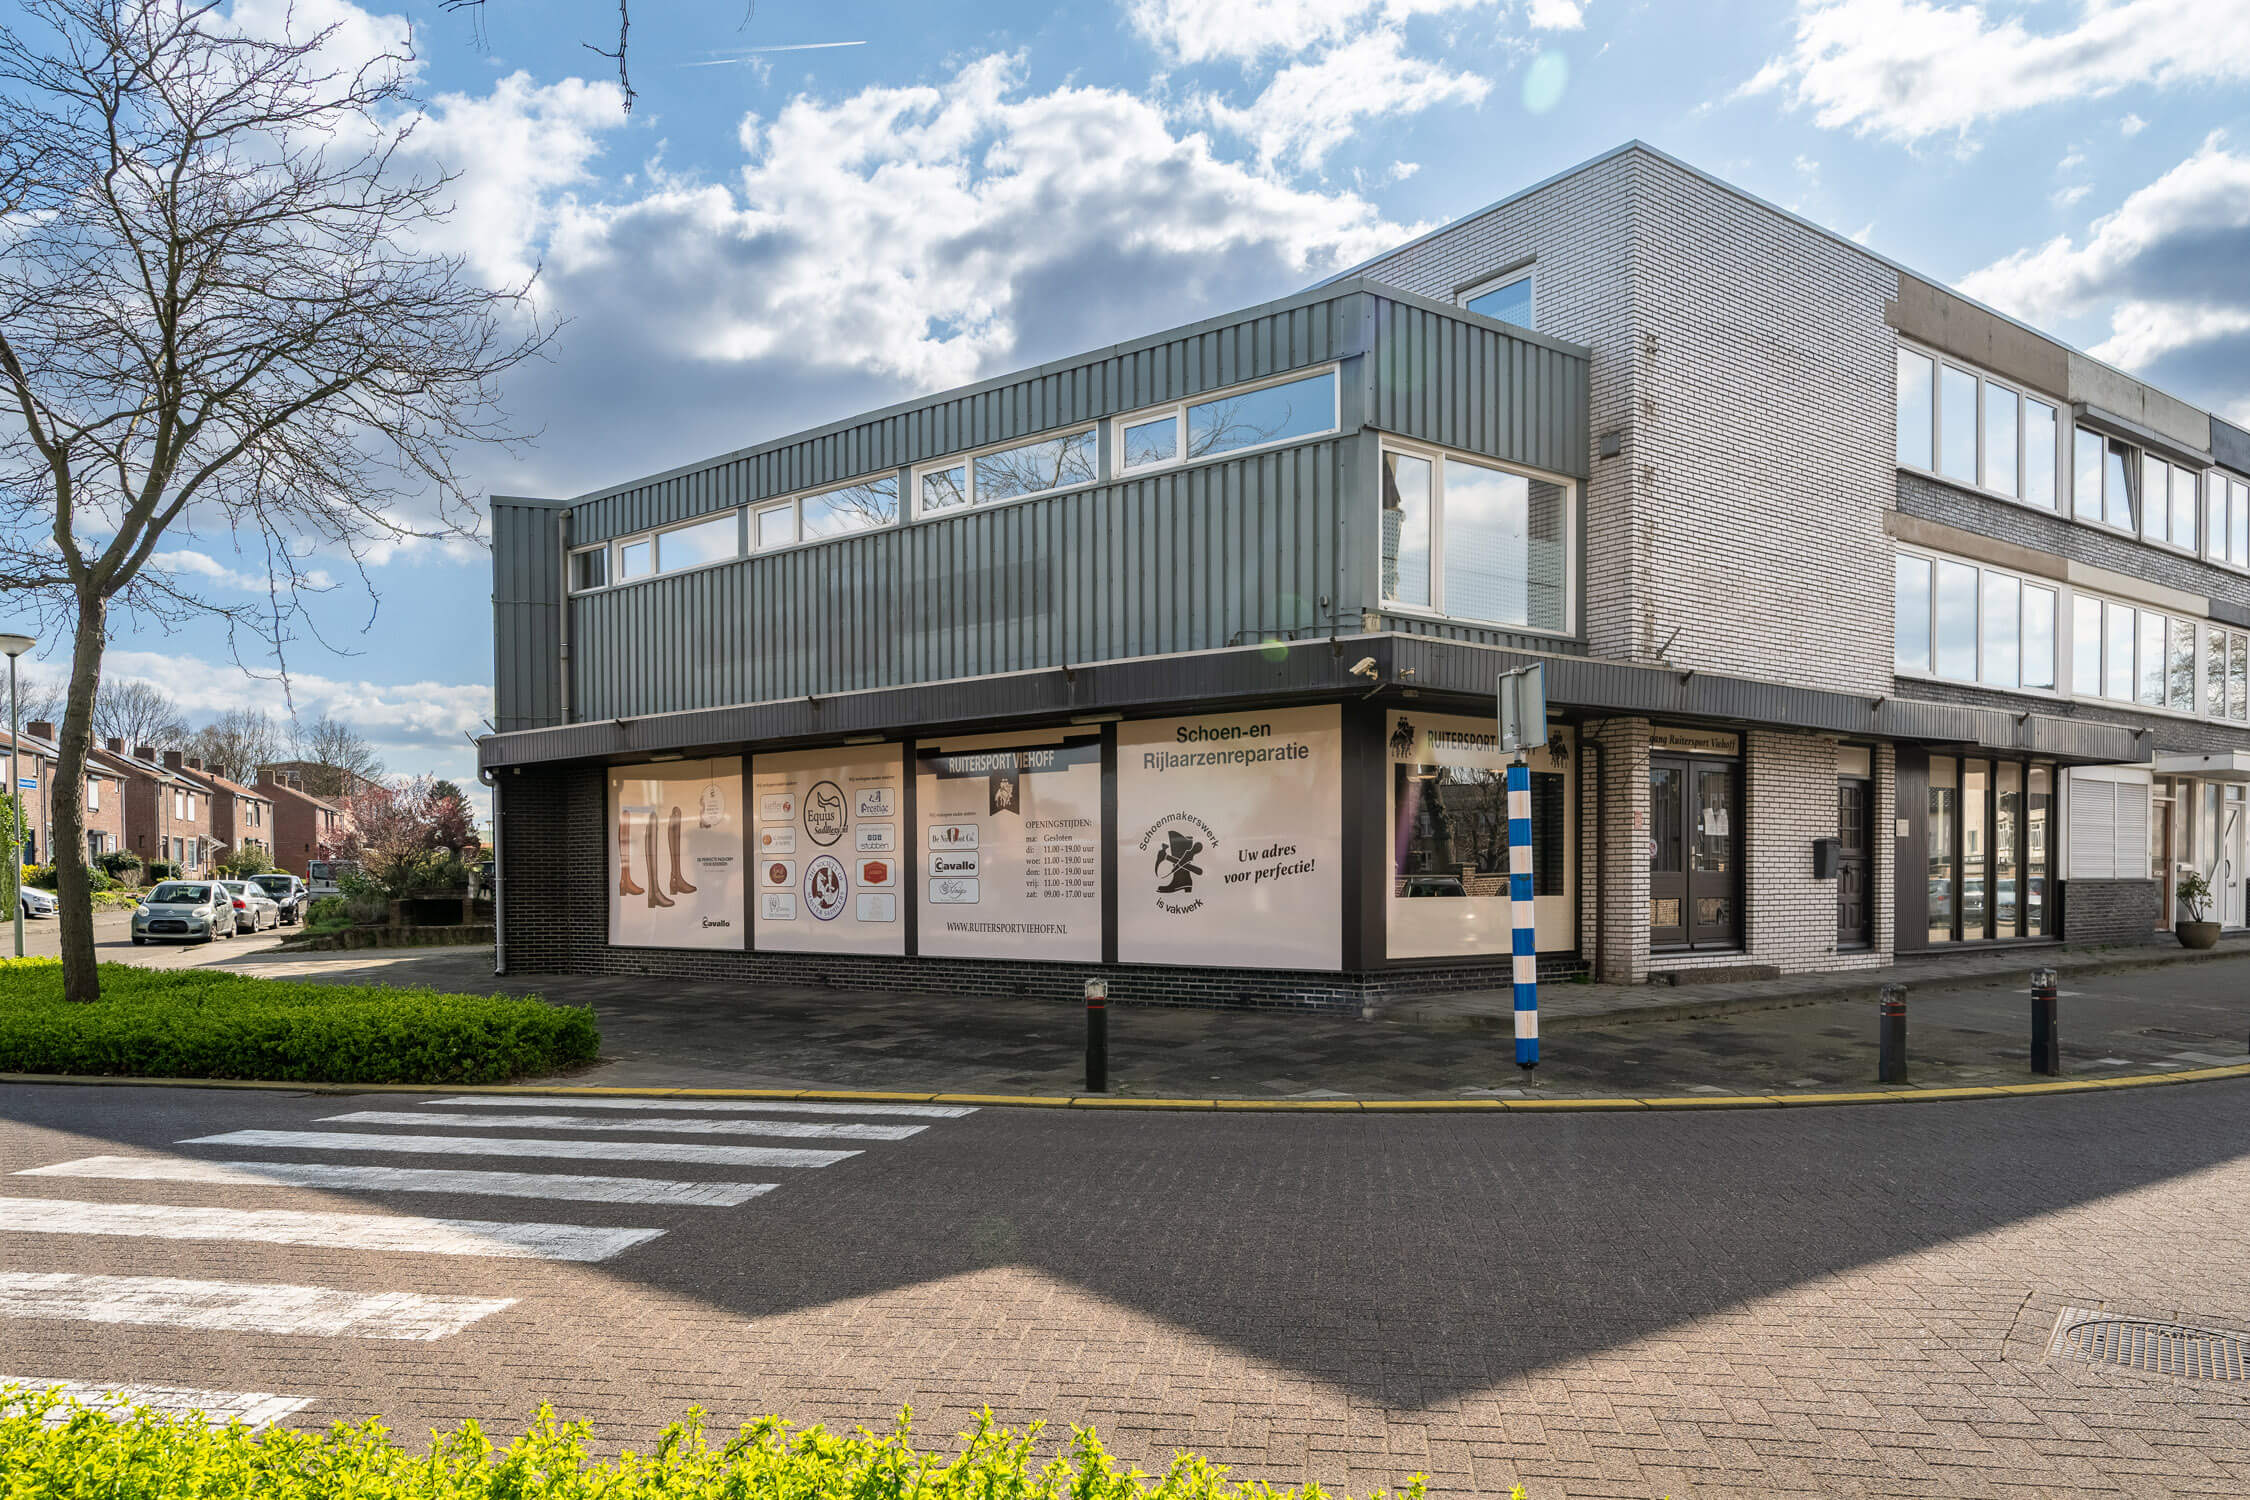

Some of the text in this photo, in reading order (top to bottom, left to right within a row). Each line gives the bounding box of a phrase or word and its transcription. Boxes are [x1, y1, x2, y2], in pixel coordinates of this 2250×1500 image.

[1176, 723, 1271, 743] Schoen-en
[1427, 729, 1496, 752] RUITERSPORT
[949, 750, 1054, 773] RUITERSPORT VIEHOFF
[1143, 742, 1310, 772] Rijlaarzenreparatie
[808, 810, 835, 825] Equus
[1025, 819, 1092, 829] OPENINGSTIJDEN:
[1043, 834, 1073, 842] Gesloten
[1139, 811, 1219, 851] Schoenmakerswerk
[1044, 845, 1060, 853] 11.00
[1065, 845, 1081, 853] 19.00
[1238, 844, 1296, 862] Uw adres
[935, 857, 976, 873] Cavallo
[1044, 857, 1060, 865] 11.00
[1065, 857, 1081, 865] 19.00
[1044, 868, 1060, 876] 11.00
[1065, 868, 1081, 876] 19.00
[1224, 859, 1316, 884] voor perfectie!
[1044, 879, 1060, 887] 11.00
[1065, 879, 1081, 887] 19.00
[1044, 890, 1060, 898] 09.00
[1065, 890, 1081, 898] 17.00
[1156, 897, 1204, 915] is vakwerk
[702, 916, 730, 929] Cavallo
[946, 922, 1067, 935] WWW.RUITERSPORTVIEHOFF.NL
